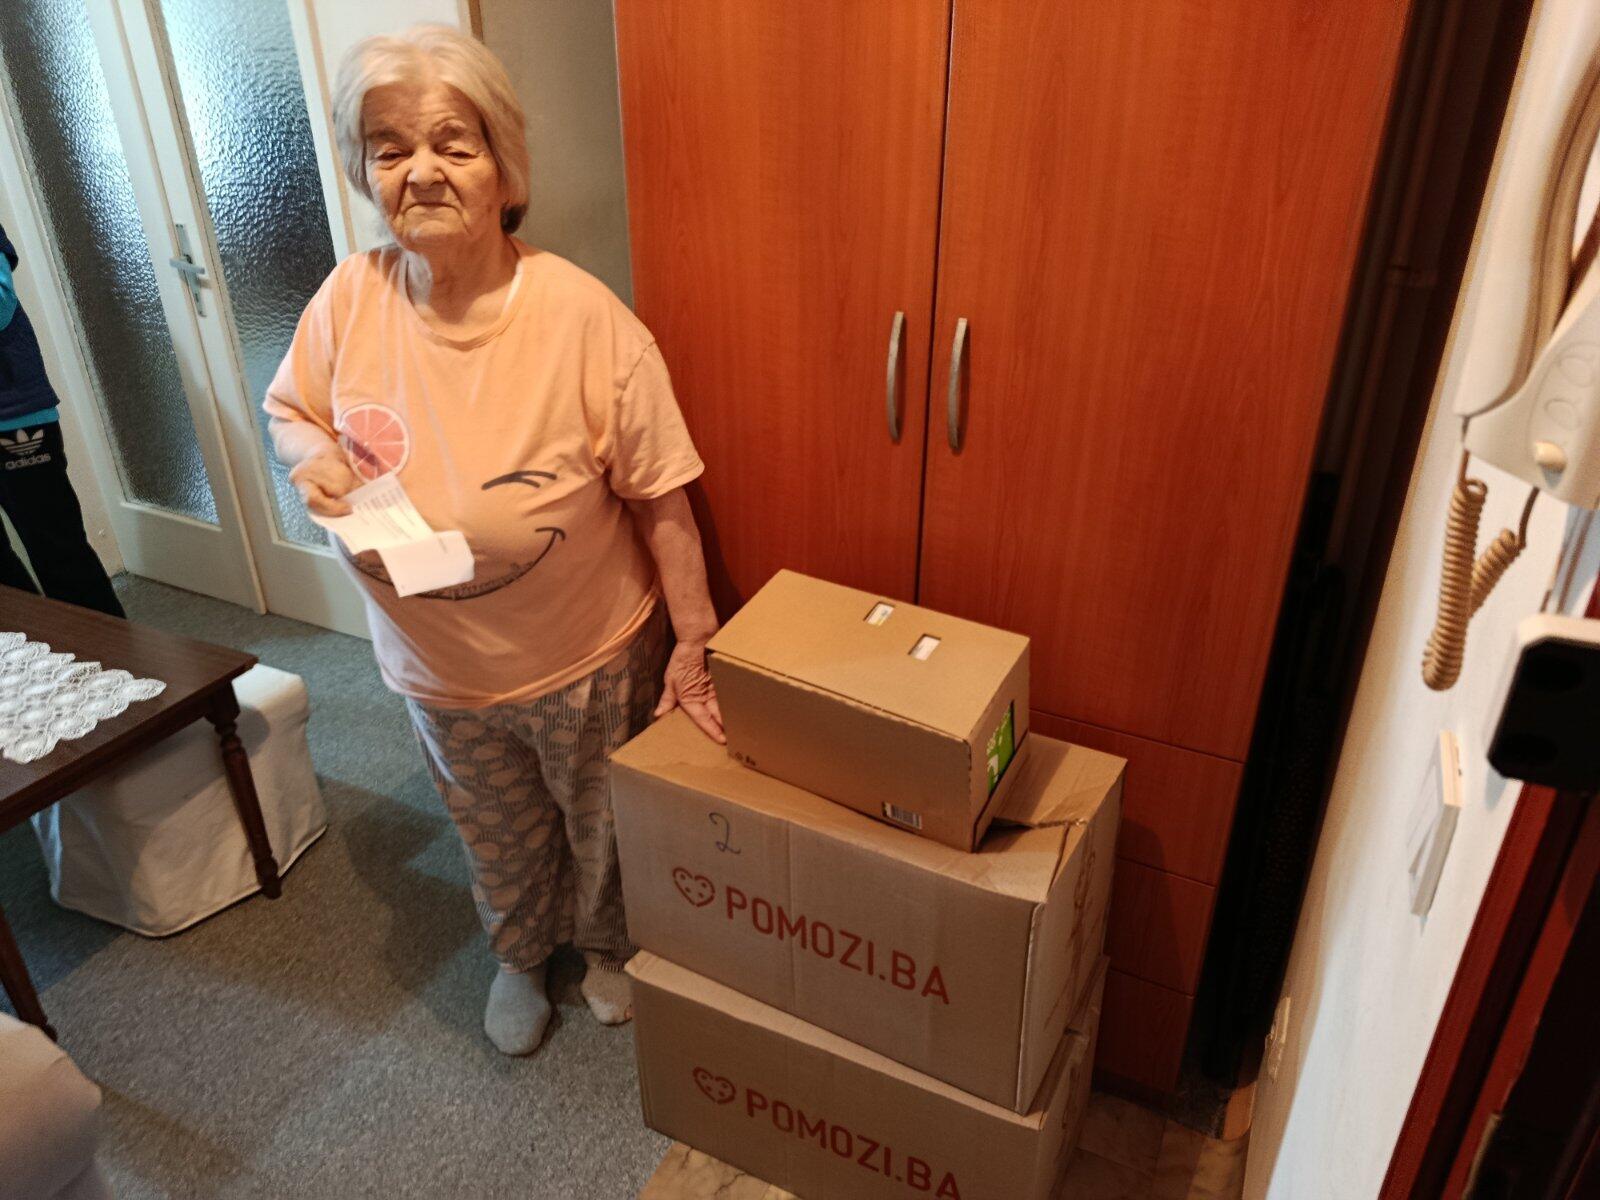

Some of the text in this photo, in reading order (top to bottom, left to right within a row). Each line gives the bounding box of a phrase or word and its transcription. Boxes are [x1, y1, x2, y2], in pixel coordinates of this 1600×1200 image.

[5, 452, 52, 471] adidas
[708, 812, 742, 855] 2
[726, 884, 950, 1005] POMOZI.BA
[746, 1088, 962, 1200] POMOZI.BA
